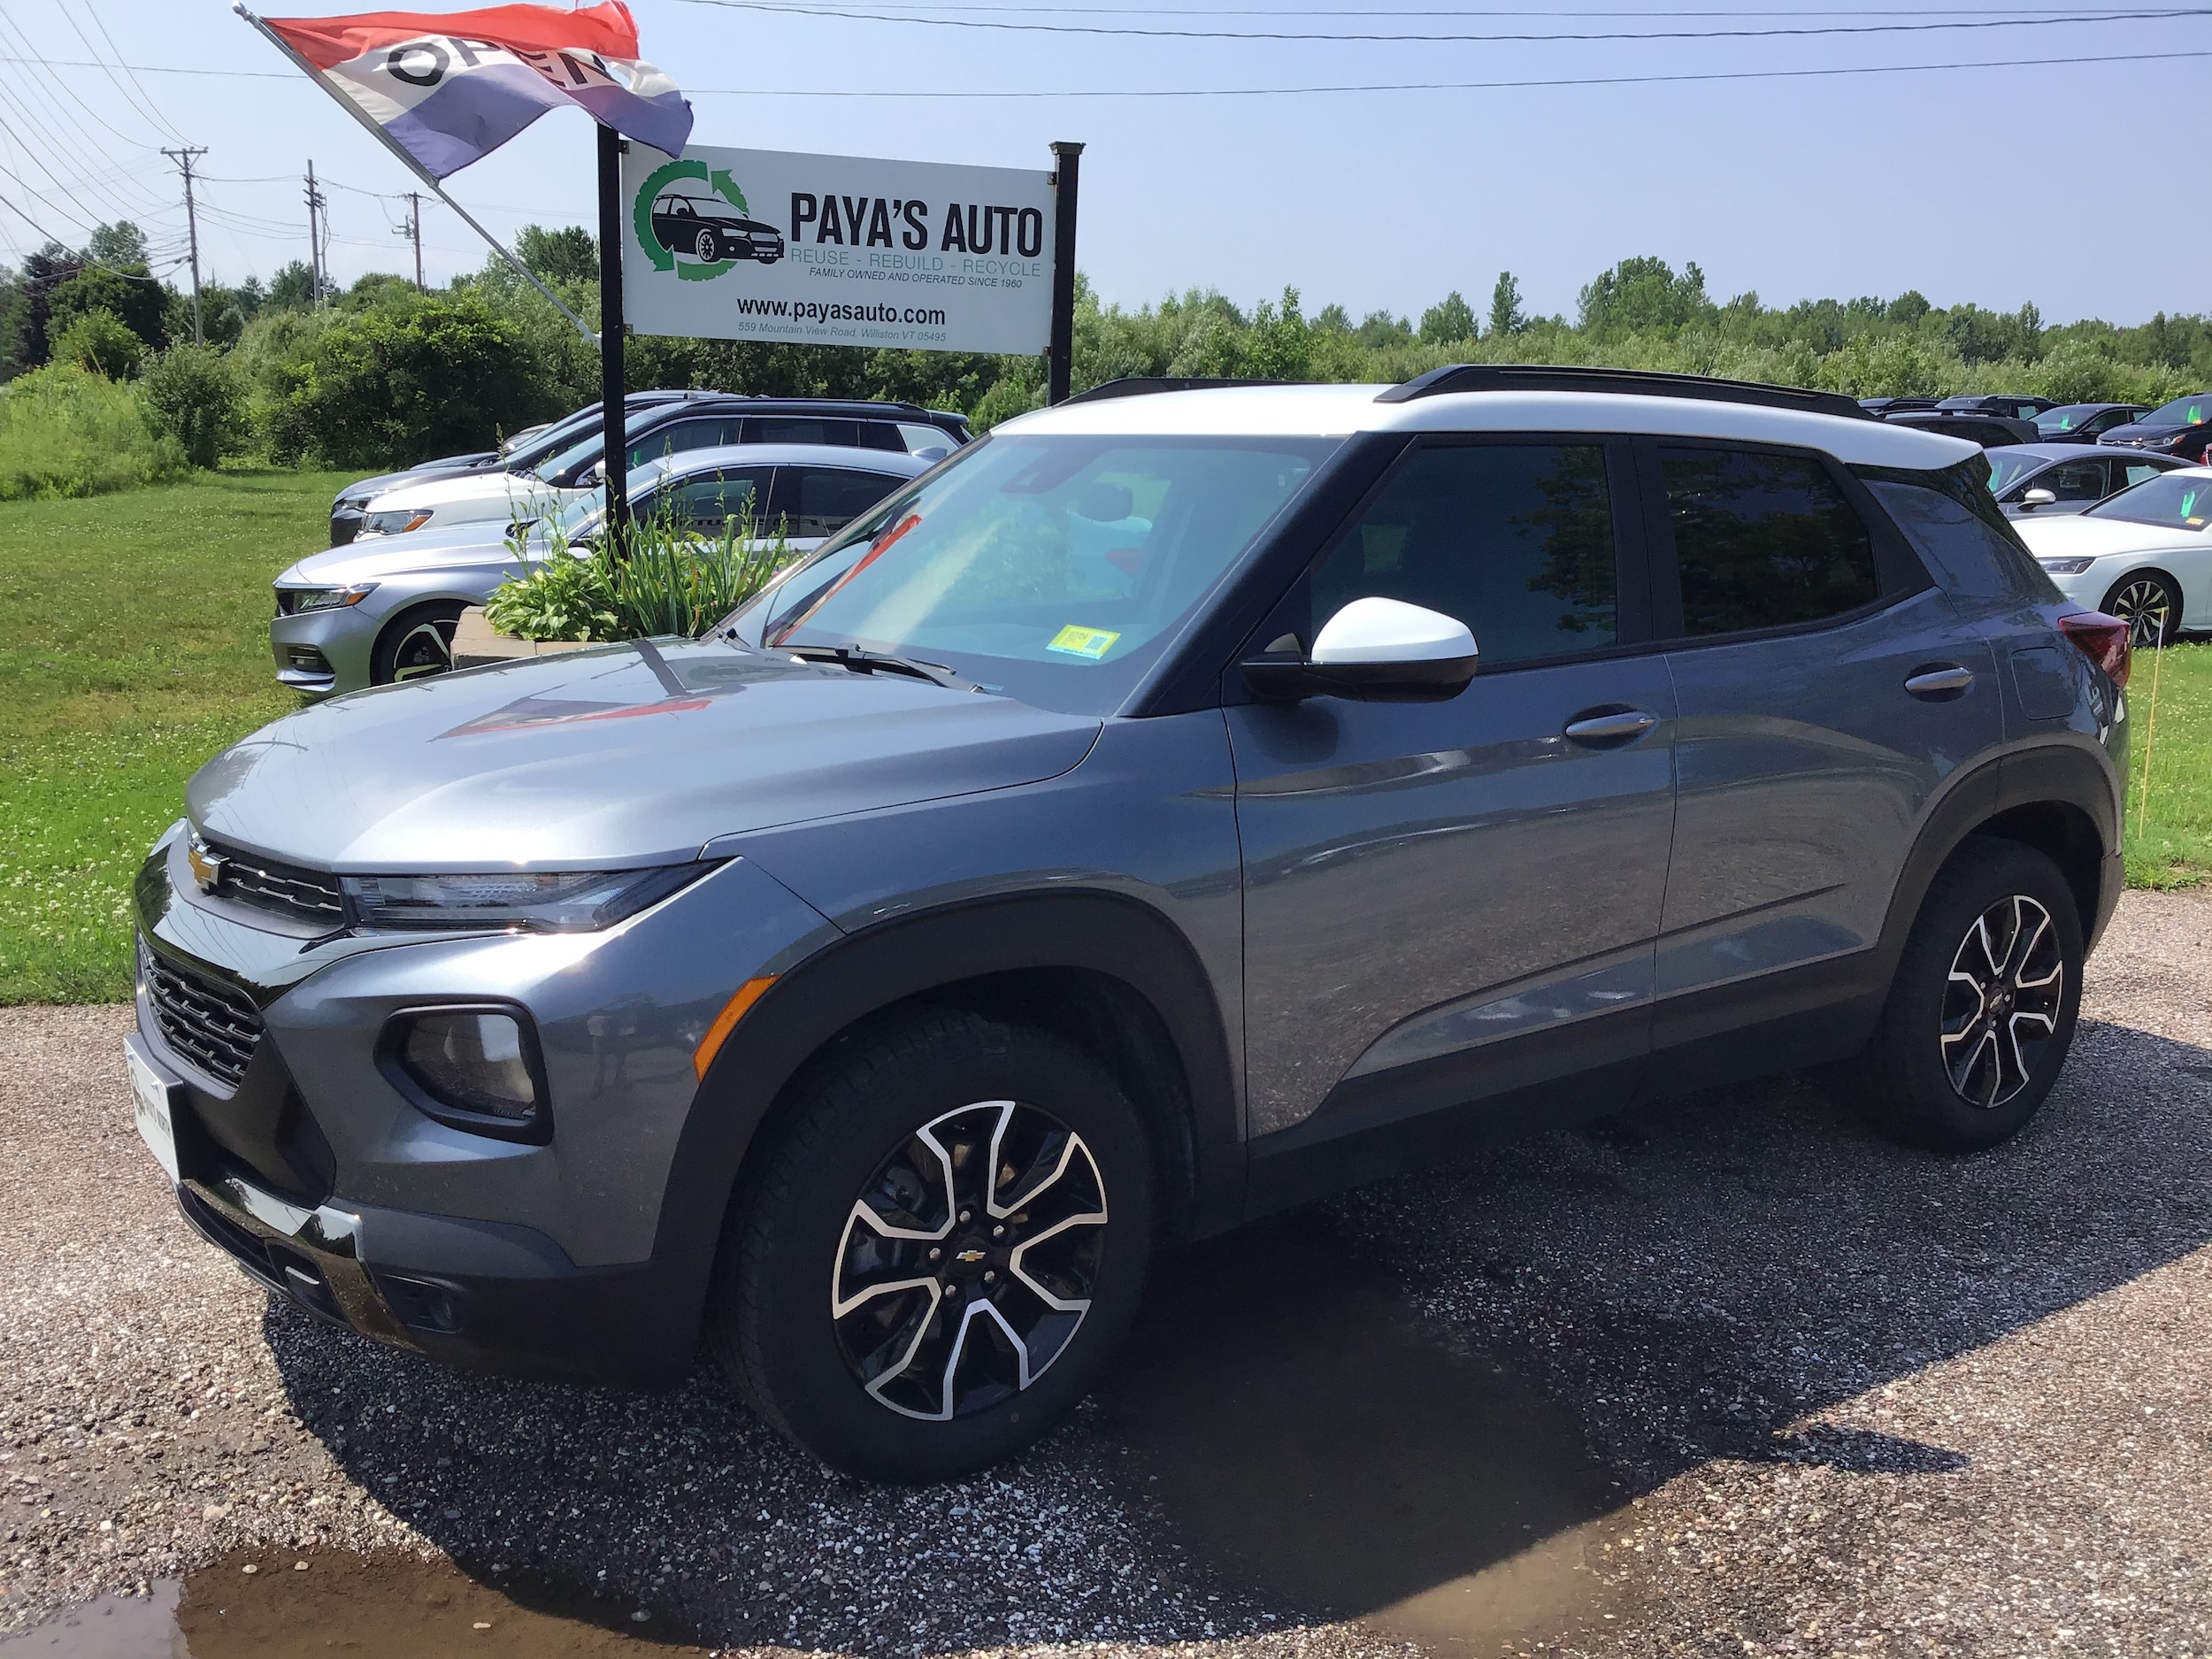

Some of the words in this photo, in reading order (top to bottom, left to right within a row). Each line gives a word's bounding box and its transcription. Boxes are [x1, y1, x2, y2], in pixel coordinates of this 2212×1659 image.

[387, 36, 623, 87] OPEN
[791, 192, 928, 250] PAYA'S
[941, 203, 1042, 257] AUTO
[791, 248, 849, 265] REUSE
[870, 253, 943, 272] REBUILD
[963, 258, 1041, 277] RECYCLE
[809, 266, 846, 279] FAMILY
[847, 269, 887, 281] OWNED
[887, 273, 910, 282] AND
[911, 273, 965, 285] OPERATED
[967, 276, 998, 288] SINCE
[1001, 279, 1023, 288] 1960
[736, 298, 946, 326] www.payasauto.com
[738, 322, 757, 332] 559
[758, 323, 803, 334] Mountain
[806, 326, 828, 336] View
[830, 326, 857, 338] Road,
[861, 328, 900, 340] Williston
[902, 331, 916, 340] VT
[918, 332, 947, 342] 05495
